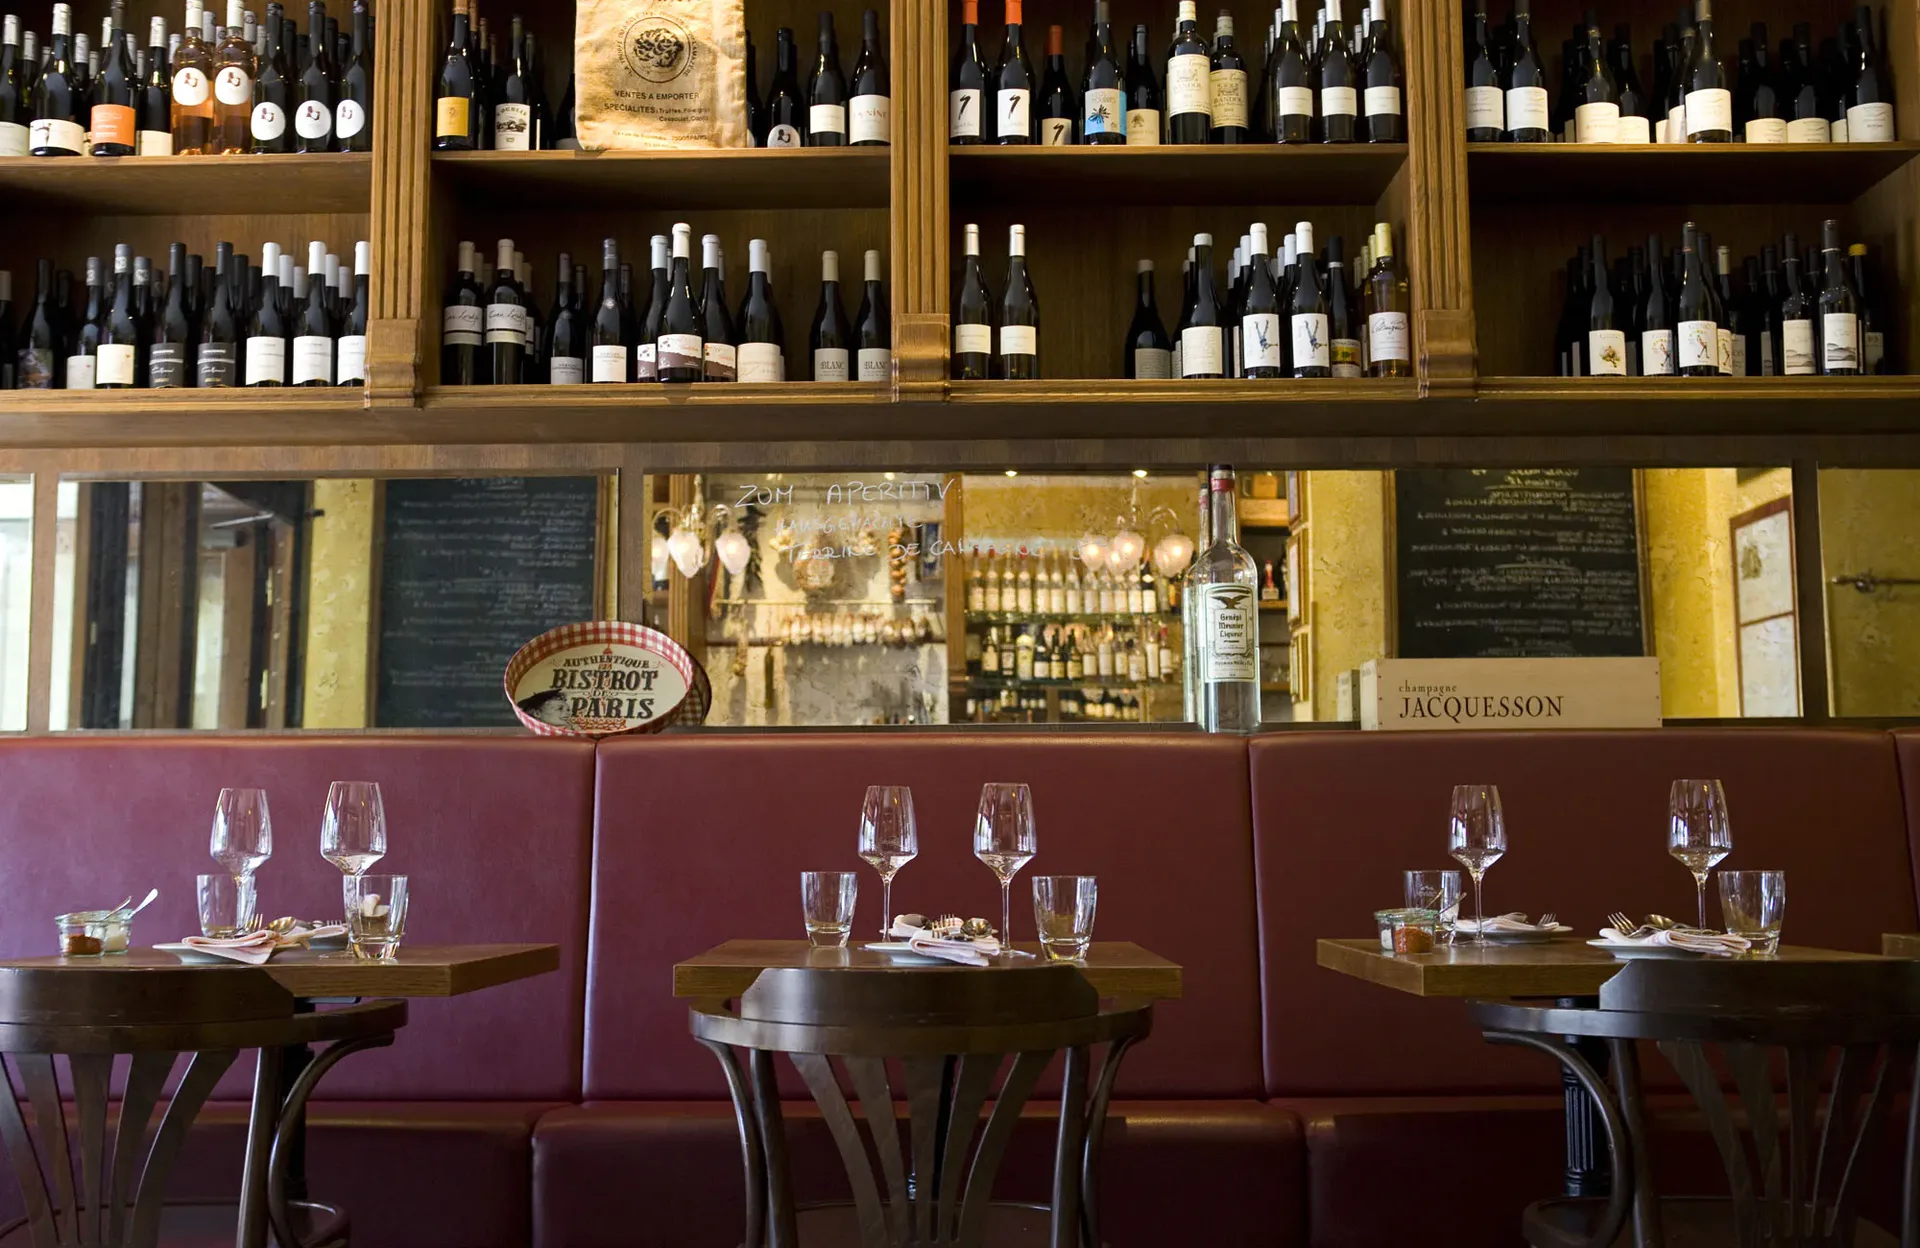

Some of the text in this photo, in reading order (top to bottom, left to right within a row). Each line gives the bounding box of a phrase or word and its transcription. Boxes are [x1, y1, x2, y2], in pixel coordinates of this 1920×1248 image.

[614, 90, 700, 100] VENTES A EMPORTER
[735, 484, 794, 508] ZUM
[888, 542, 921, 561] DE
[1218, 622, 1244, 630] Meunier
[1220, 630, 1243, 638] Liqueur
[563, 655, 650, 669] AUTHENTIQUE
[550, 669, 659, 691] BISTROT
[1399, 680, 1458, 697] champagne
[570, 697, 655, 719] PARIS
[1400, 696, 1565, 724] JACQUESSON
